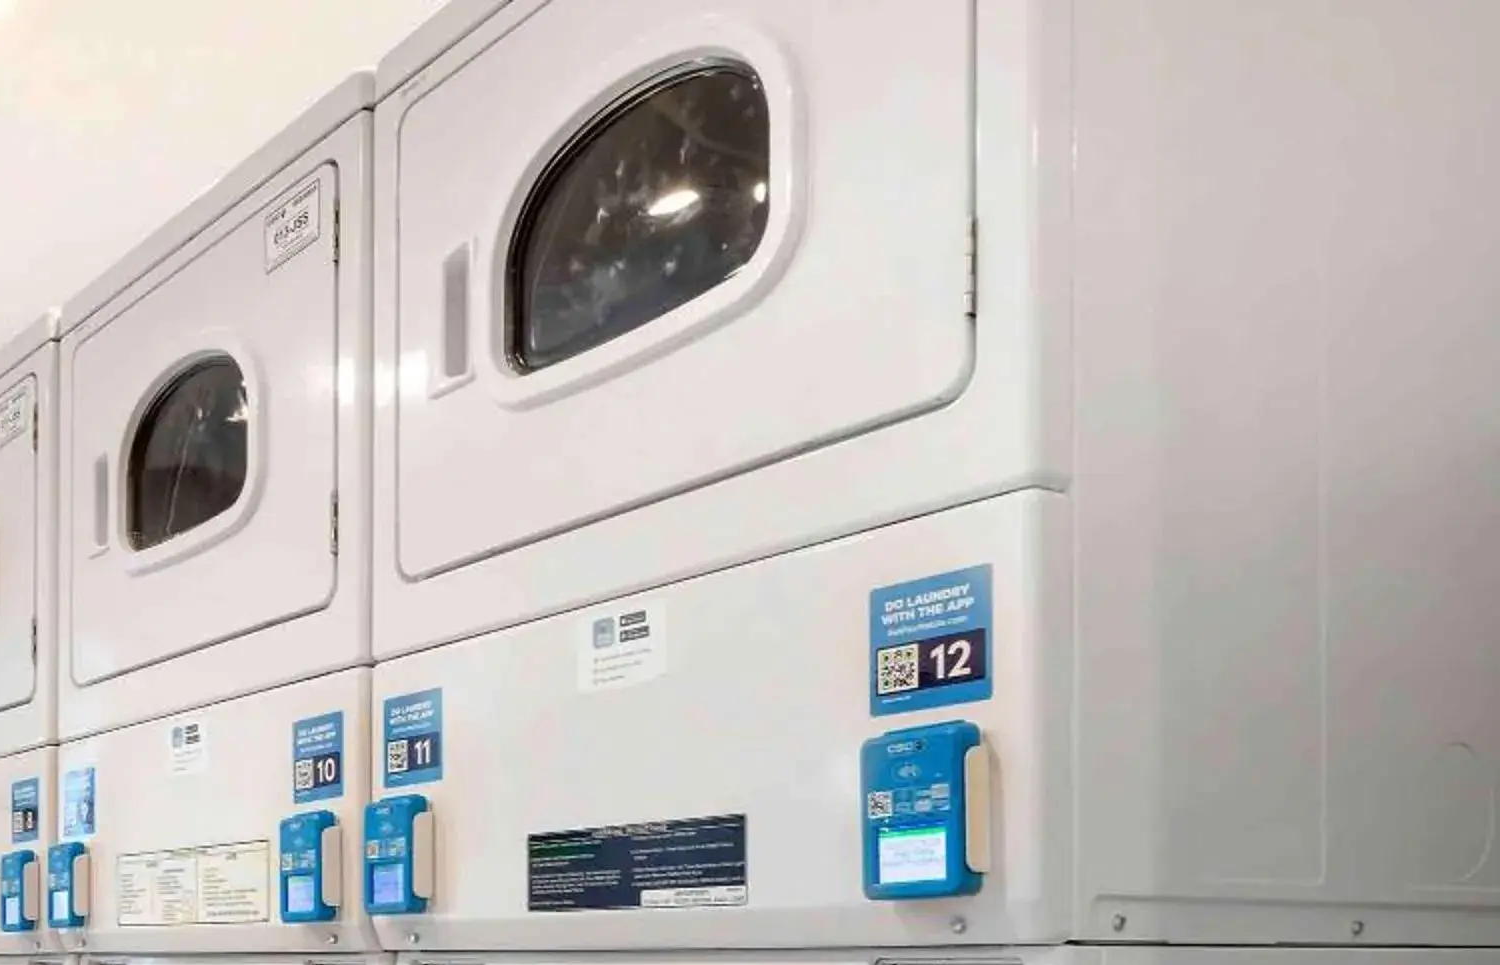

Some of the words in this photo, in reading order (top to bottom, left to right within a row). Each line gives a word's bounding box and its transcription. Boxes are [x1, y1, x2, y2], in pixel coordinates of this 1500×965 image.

[881, 610, 915, 626] WITH
[917, 603, 944, 618] THE
[946, 596, 975, 612] APP
[884, 600, 903, 613] DO
[907, 583, 971, 607] LAUNDRY
[929, 639, 972, 680] 12
[414, 738, 432, 766] 11
[316, 758, 336, 784] 10
